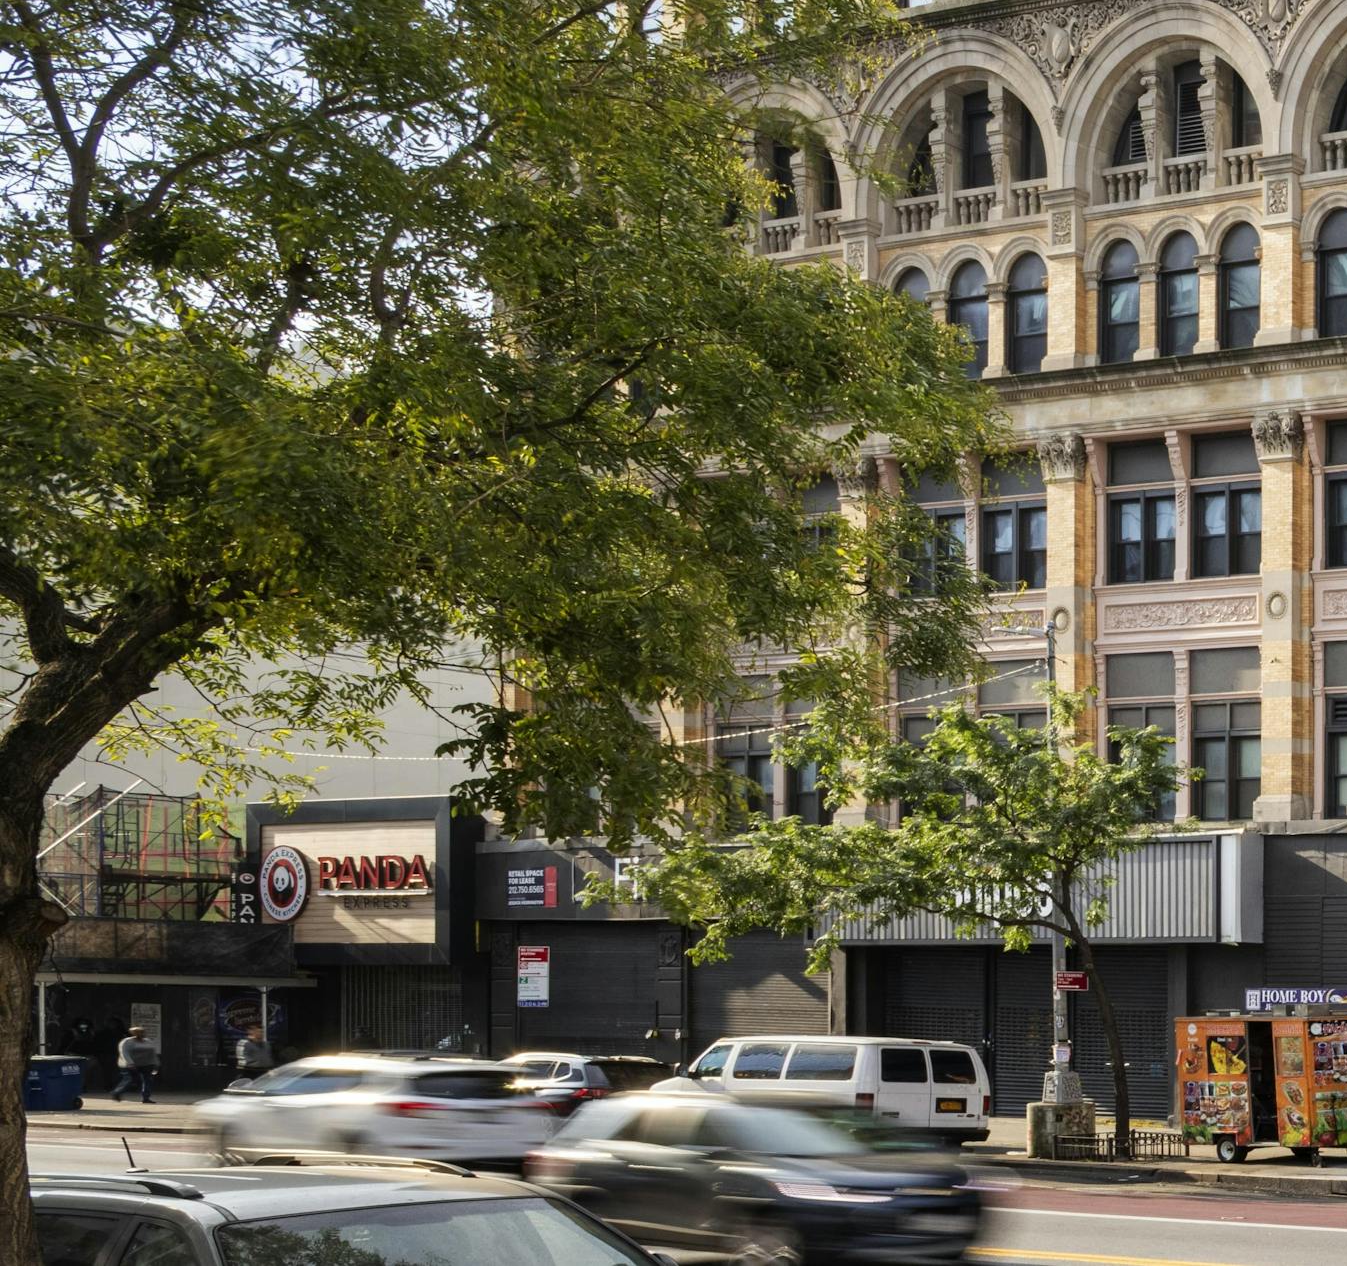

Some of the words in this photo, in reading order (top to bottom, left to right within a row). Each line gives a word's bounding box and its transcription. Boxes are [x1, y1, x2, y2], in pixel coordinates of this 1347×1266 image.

[317, 855, 430, 890] PANDA
[525, 869, 544, 877] SPACE
[508, 877, 519, 885] FOR
[343, 897, 410, 909] EXPRESS
[1262, 989, 1298, 1003] HOME
[1300, 989, 1327, 1003] BOY
